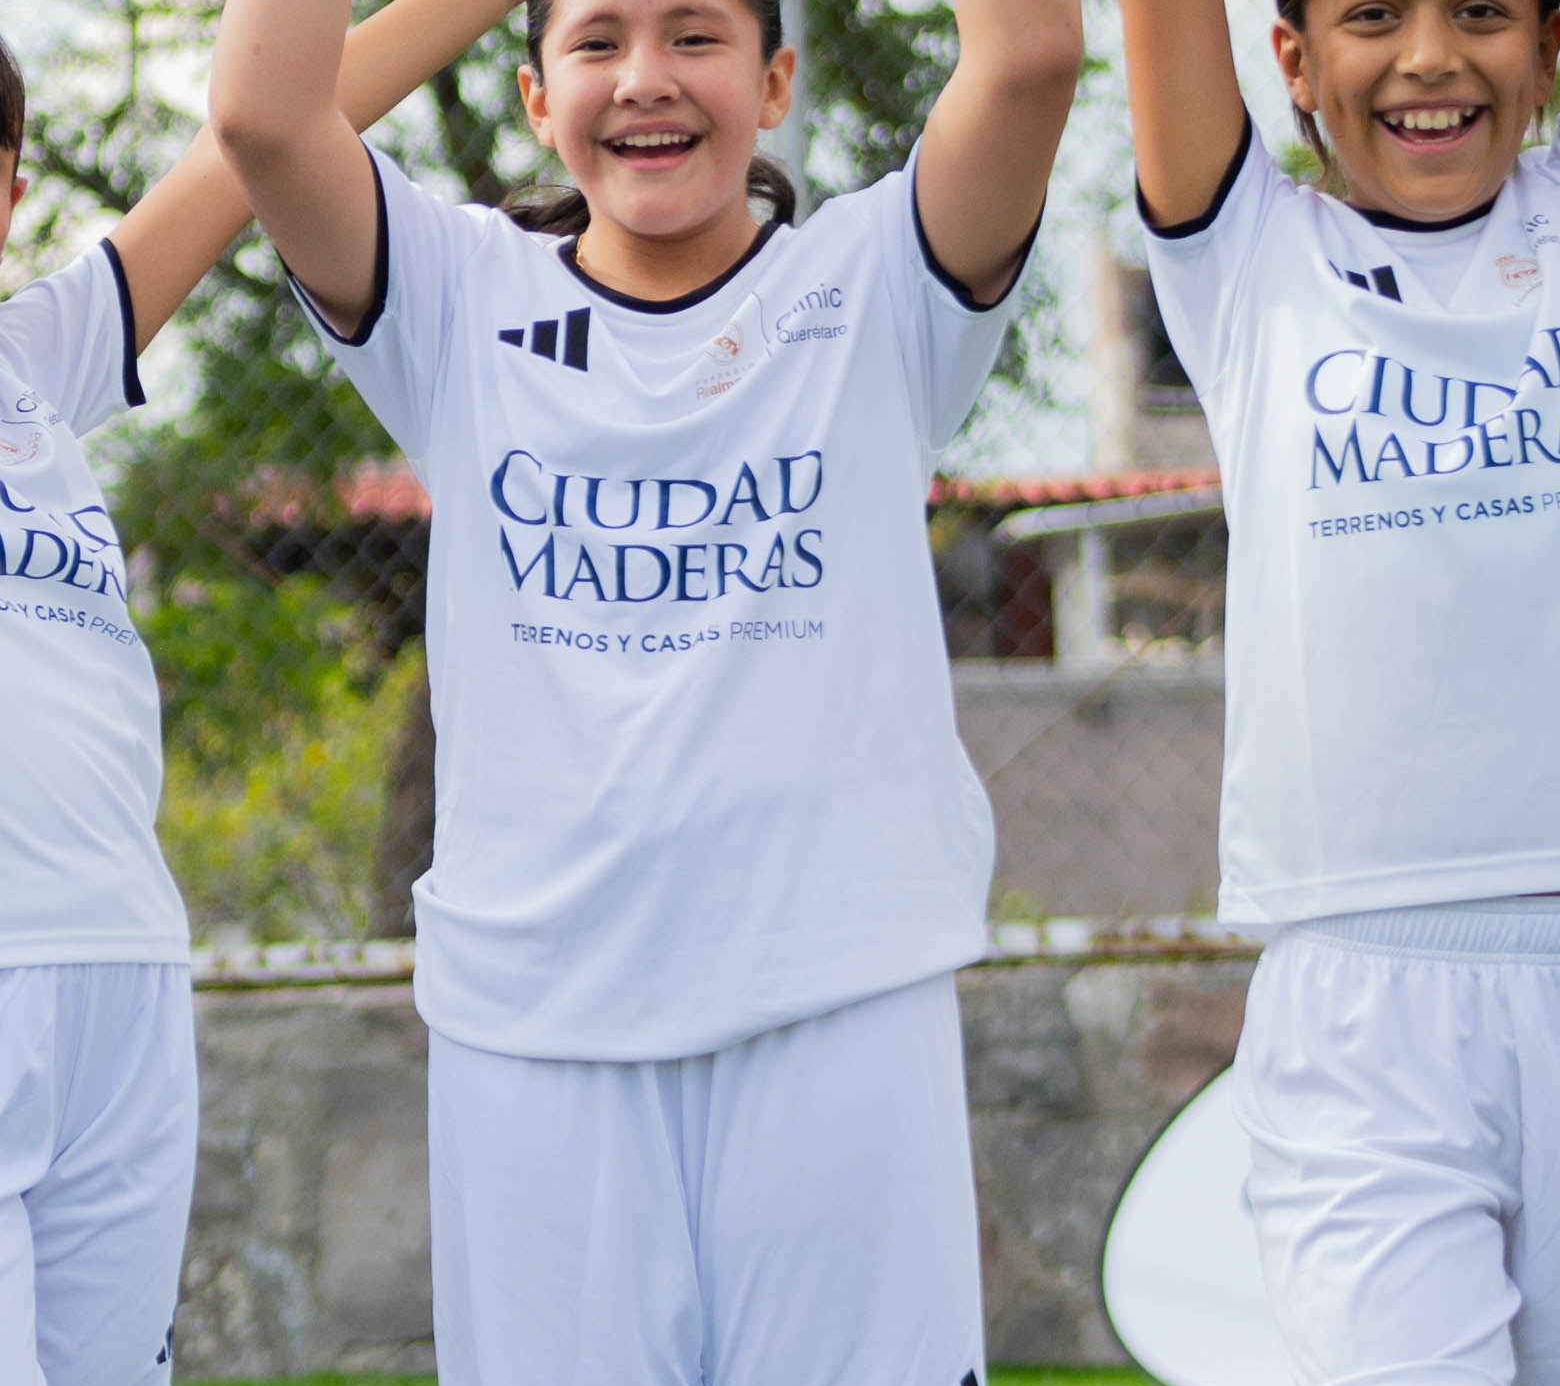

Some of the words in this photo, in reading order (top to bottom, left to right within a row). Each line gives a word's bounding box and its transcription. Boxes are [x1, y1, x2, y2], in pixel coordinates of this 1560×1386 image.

[490, 449, 823, 531] CIUDAD
[1309, 507, 1424, 539] TERRENOS
[1431, 505, 1448, 524] Y
[1455, 495, 1536, 522] CASAS
[499, 525, 823, 603] MADERAS
[617, 634, 632, 653] Y
[640, 625, 721, 653] CASAS
[729, 620, 824, 642] PREMIUM
